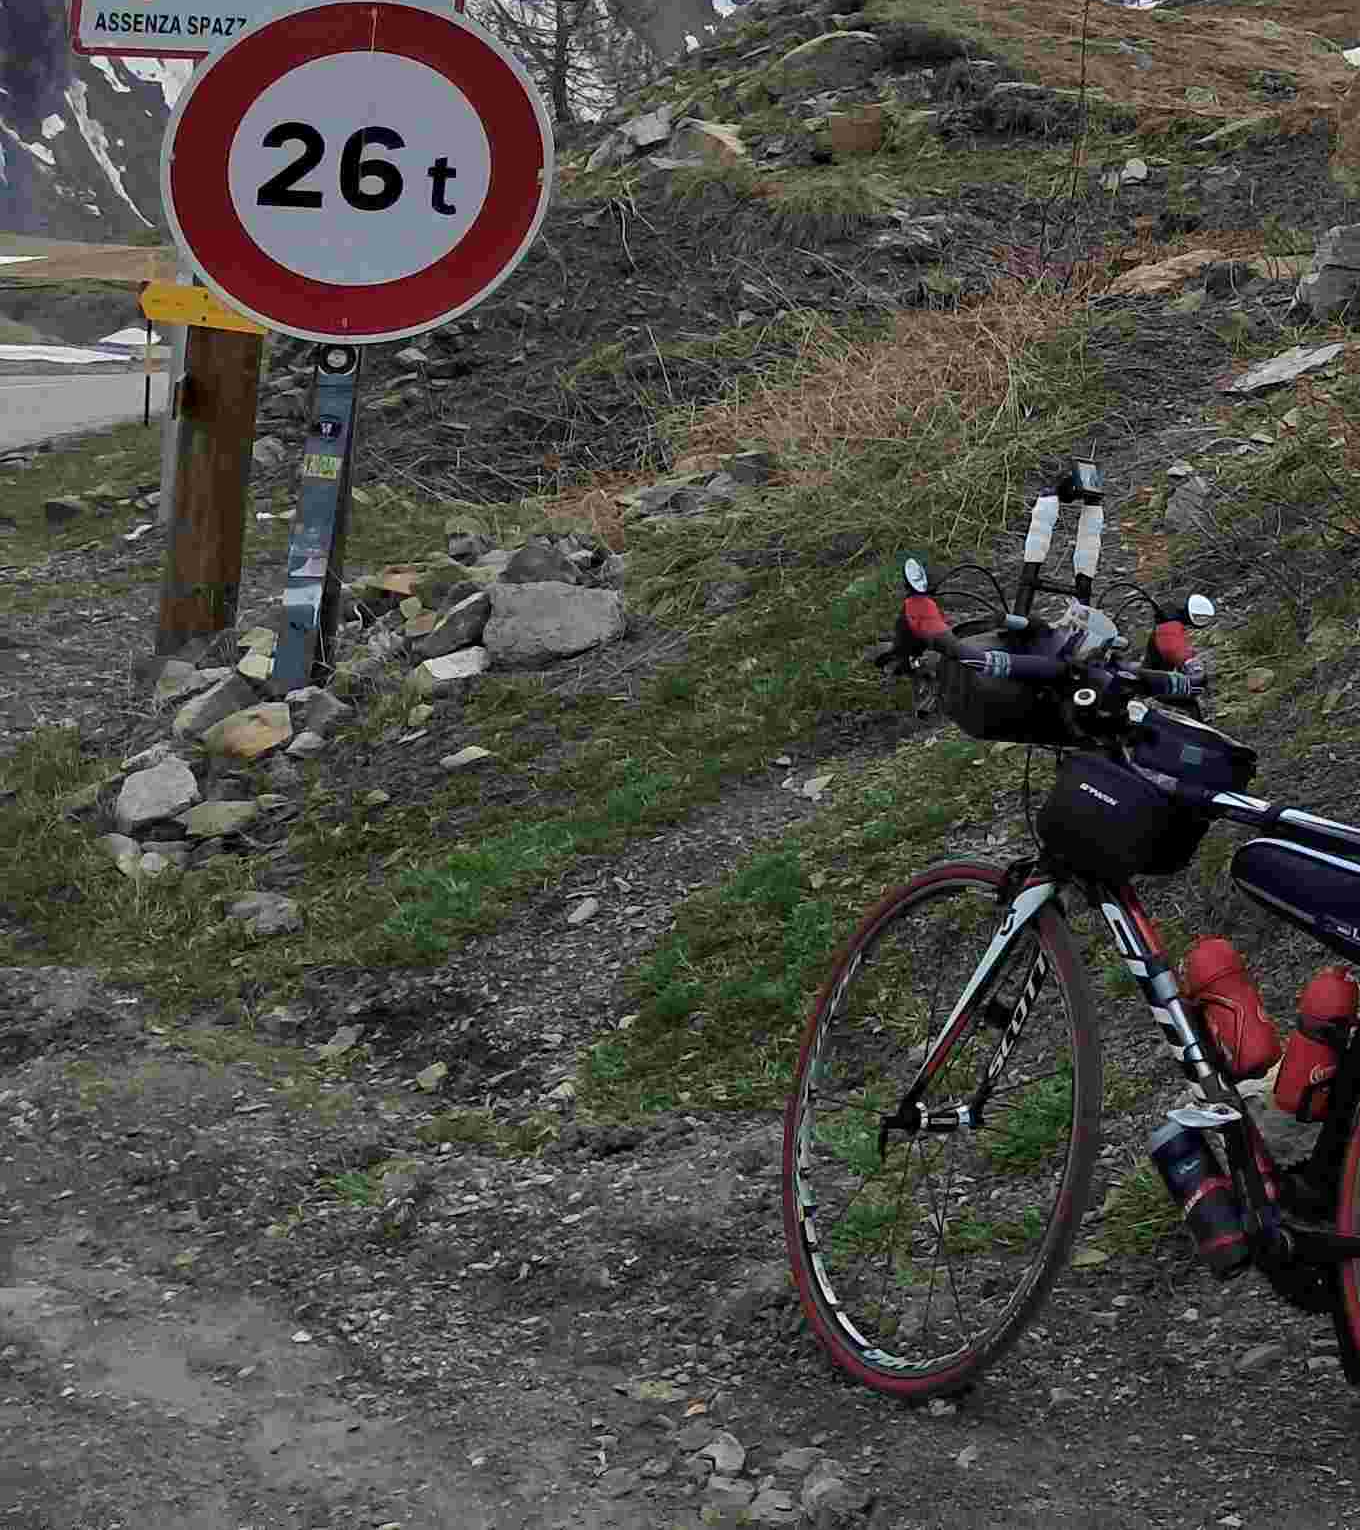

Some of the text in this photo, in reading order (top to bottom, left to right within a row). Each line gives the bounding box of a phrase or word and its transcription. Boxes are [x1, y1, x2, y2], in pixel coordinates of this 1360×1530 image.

[94, 11, 182, 35] ASSENZA
[255, 121, 458, 216] 26 t
